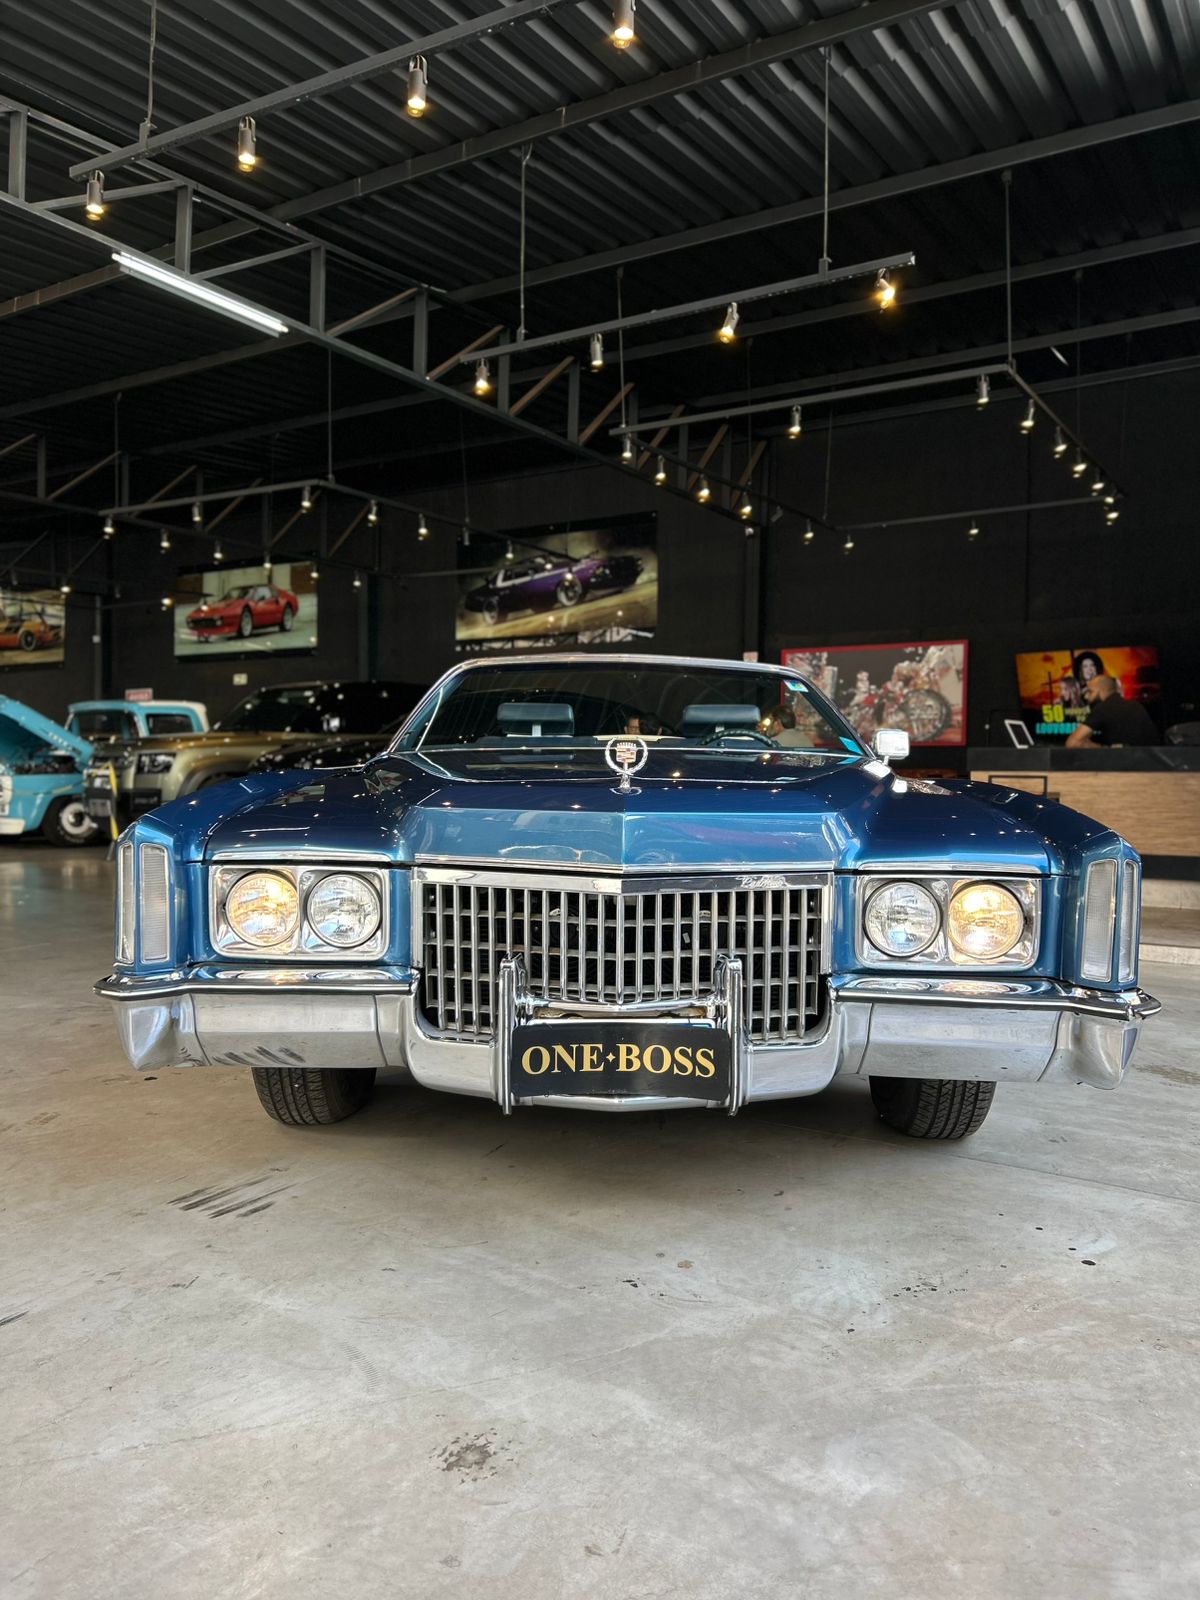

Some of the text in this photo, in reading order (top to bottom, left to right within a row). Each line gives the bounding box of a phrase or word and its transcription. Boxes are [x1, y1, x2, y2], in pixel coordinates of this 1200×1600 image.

[1042, 704, 1064, 722] 50
[521, 1043, 716, 1078] ONE BOSS
